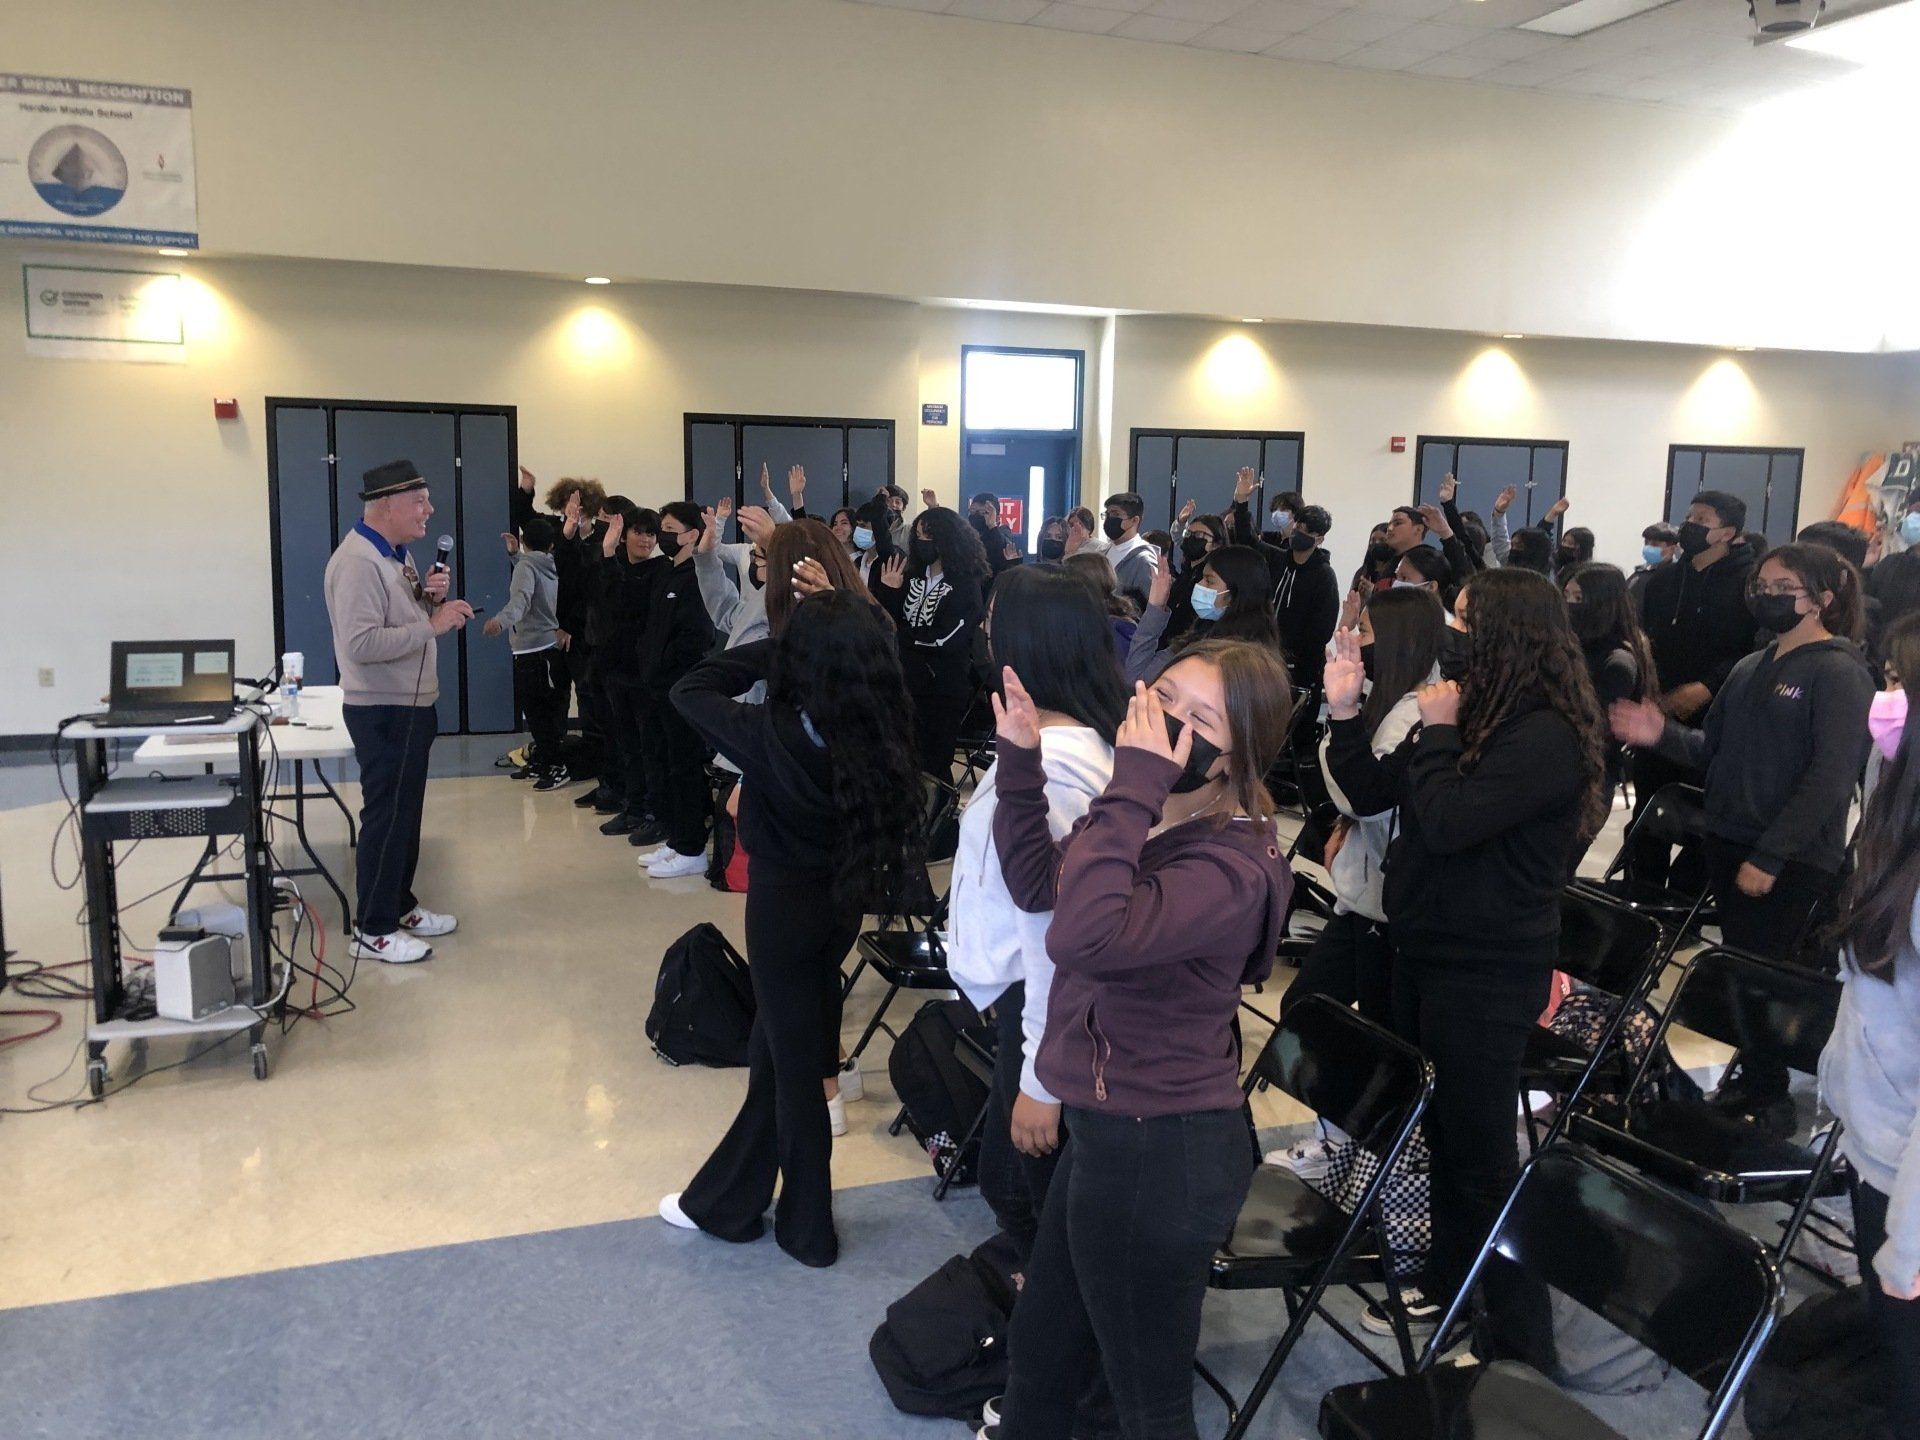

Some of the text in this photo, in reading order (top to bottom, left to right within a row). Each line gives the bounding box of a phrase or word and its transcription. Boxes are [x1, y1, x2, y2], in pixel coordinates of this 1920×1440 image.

[78, 82, 185, 104] RECOGNITION
[97, 108, 133, 120] School
[1774, 683, 1804, 700] PINK
[404, 914, 424, 928] N
[372, 935, 391, 951] N
